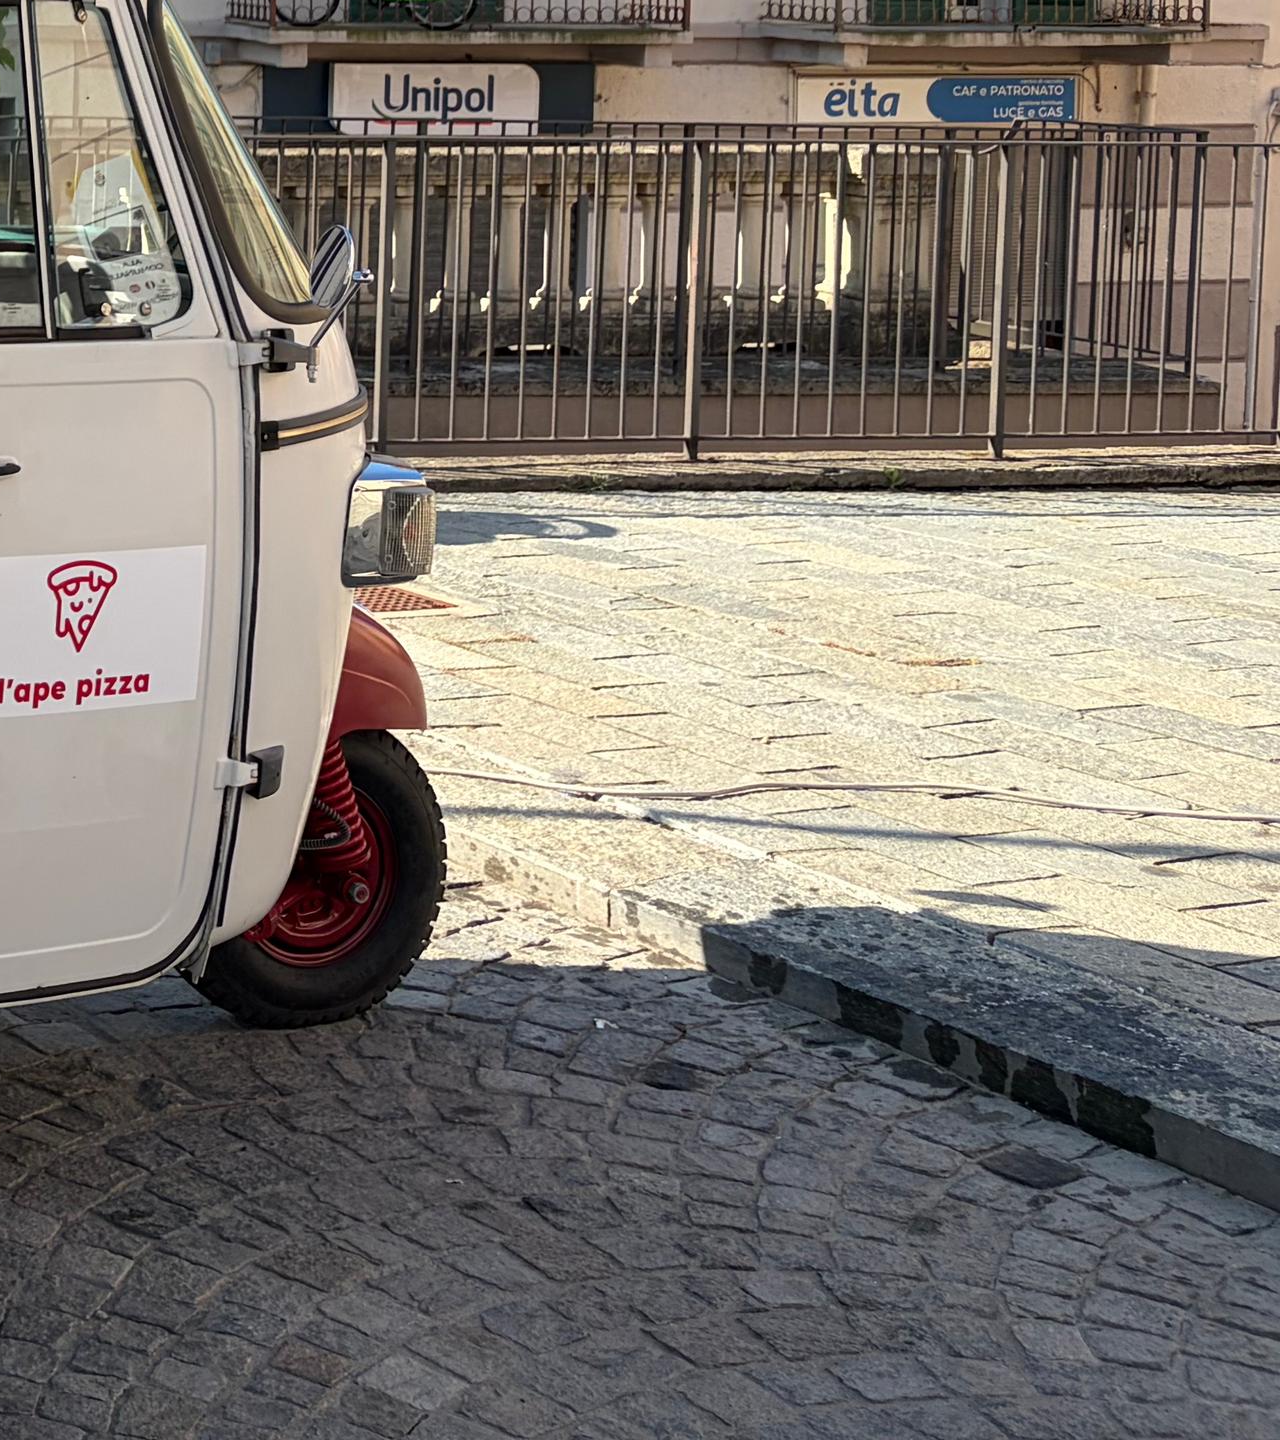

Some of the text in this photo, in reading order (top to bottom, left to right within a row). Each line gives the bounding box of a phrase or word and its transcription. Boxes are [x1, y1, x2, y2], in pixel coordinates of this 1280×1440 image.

[383, 73, 495, 125] Unipol
[952, 85, 1065, 97] CAF e PATRONATO
[993, 107, 1064, 119] LUCE e GAS
[75, 668, 151, 706] pizza
